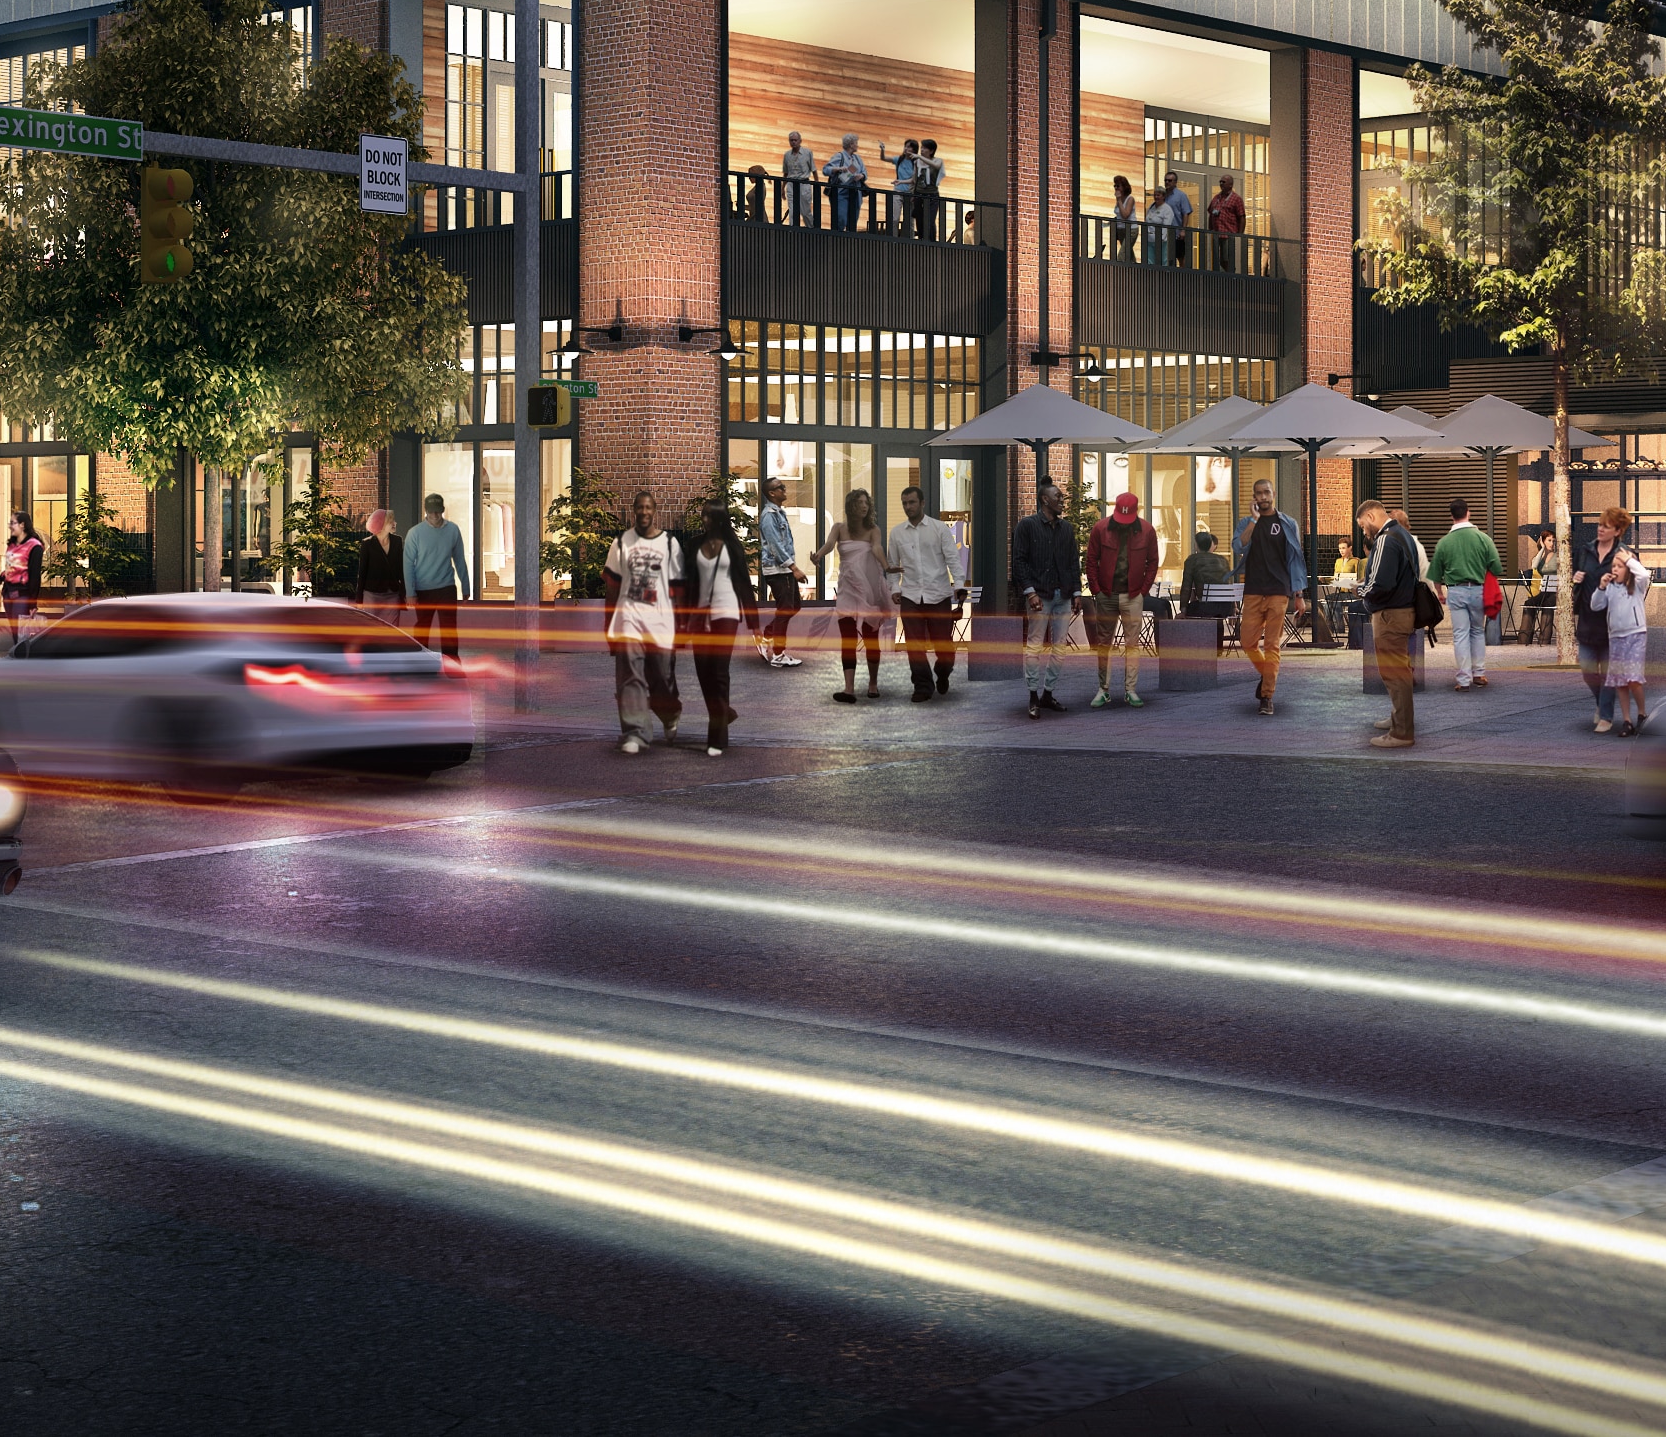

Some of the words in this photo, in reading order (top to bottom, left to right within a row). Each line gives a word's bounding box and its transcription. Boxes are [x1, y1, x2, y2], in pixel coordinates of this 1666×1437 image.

[117, 125, 142, 150] St
[365, 149, 380, 164] DO
[382, 151, 403, 166] NOT
[367, 169, 401, 187] BLOCK
[364, 190, 404, 202] INTERSECTION
[588, 383, 598, 394] St
[1122, 506, 1129, 514] H
